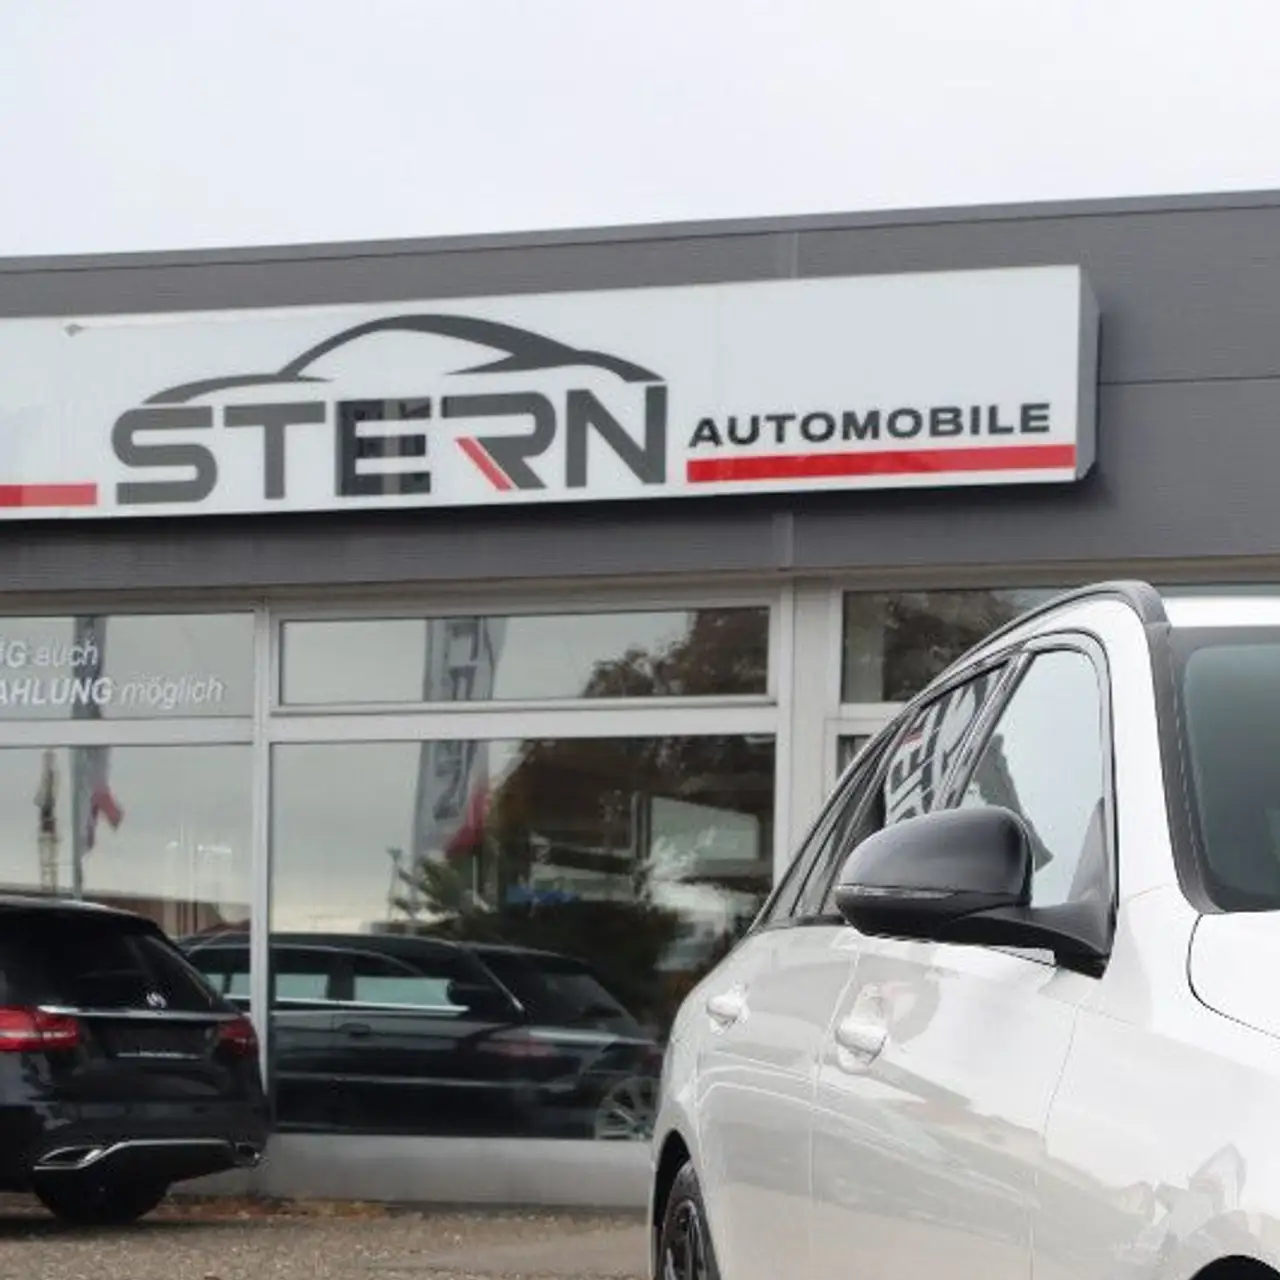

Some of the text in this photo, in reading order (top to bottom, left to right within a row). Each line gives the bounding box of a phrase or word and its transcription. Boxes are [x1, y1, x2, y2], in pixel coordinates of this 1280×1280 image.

[111, 386, 1051, 505] STERN AUTOMOBILE
[33, 640, 98, 667] auch
[120, 676, 224, 710] möglich
